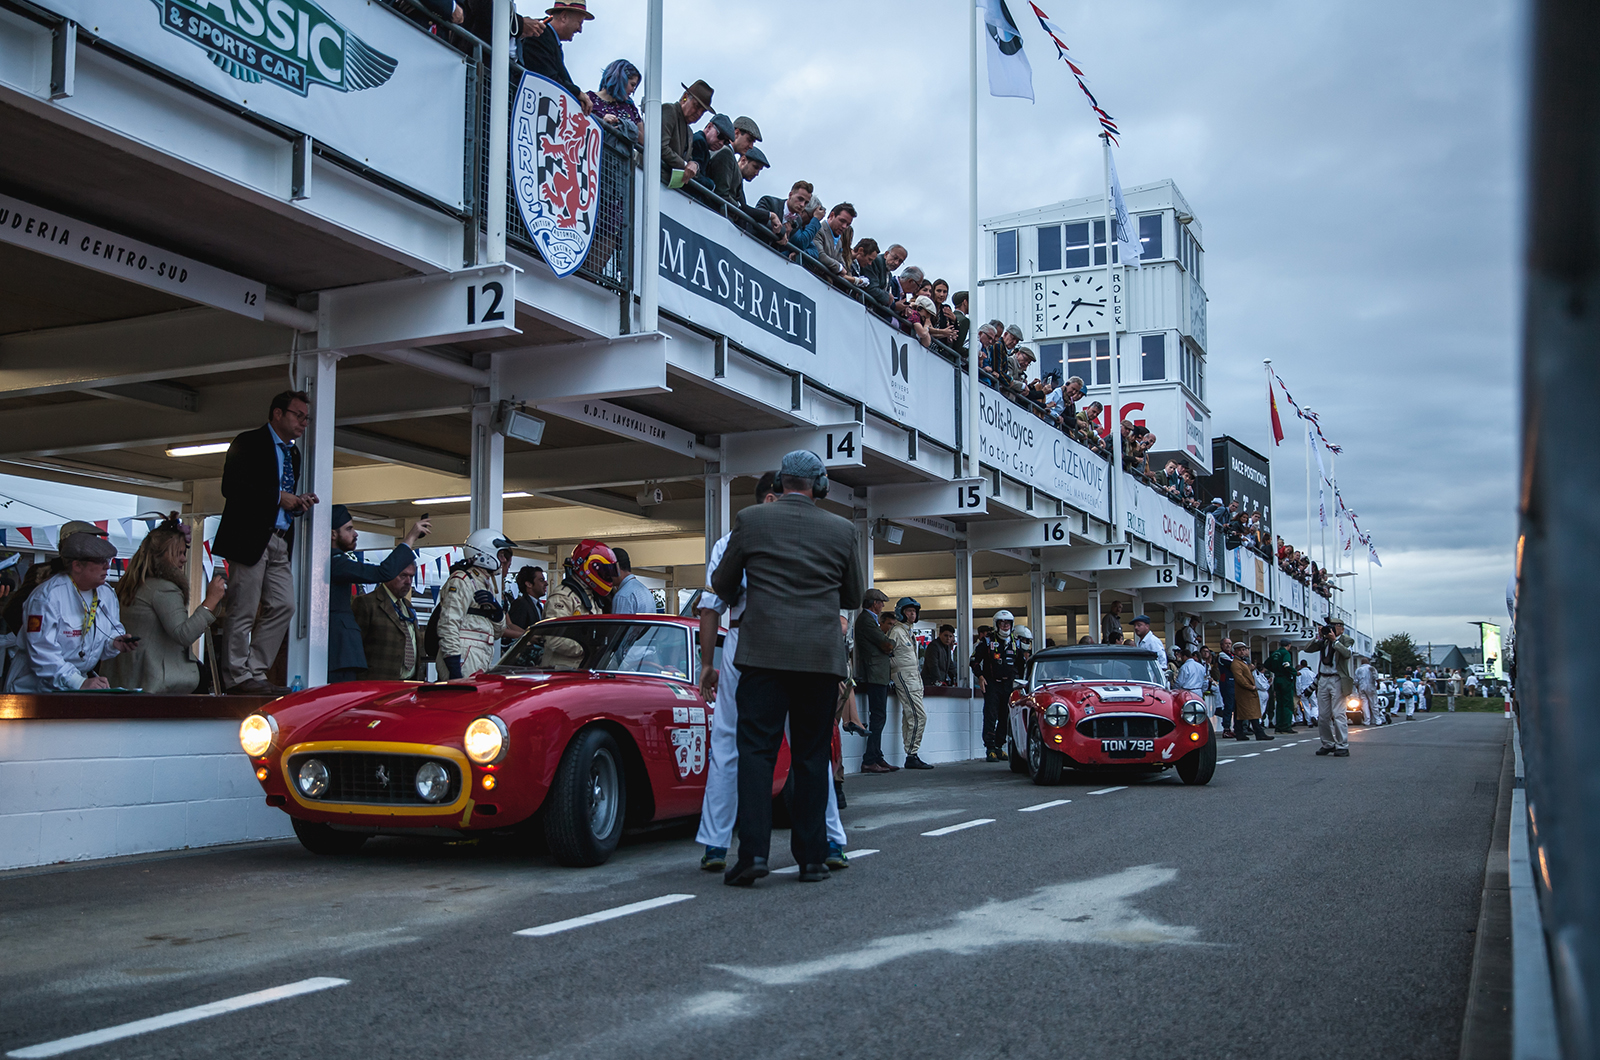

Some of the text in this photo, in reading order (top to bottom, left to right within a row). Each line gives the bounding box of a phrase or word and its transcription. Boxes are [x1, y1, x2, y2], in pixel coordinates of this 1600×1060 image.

[169, 6, 301, 86] & SPORTS CAR
[518, 87, 537, 206] BARC
[80, 235, 188, 284] CENTRO-SUD
[244, 291, 257, 306] 12
[659, 227, 813, 345] MASERATI
[1113, 273, 1122, 325] ROLEX
[466, 281, 505, 325] 12
[1034, 282, 1044, 333] ROLEX
[649, 425, 666, 440] TEAM
[979, 391, 1034, 451] Rolls-Royce
[826, 431, 855, 461] 14
[979, 434, 1034, 477] Motor Cars
[1053, 439, 1102, 492] CAZENOVE
[1231, 456, 1267, 488] RACE POSITIONS
[958, 486, 981, 509] 15
[1043, 523, 1065, 542] 16
[1107, 549, 1124, 566] 17
[1156, 568, 1173, 584] 18
[1194, 584, 1210, 598] 19
[1243, 606, 1260, 618] 20
[1269, 616, 1281, 626] 21
[1284, 623, 1299, 633] 22
[1300, 629, 1314, 639] 23
[1101, 740, 1154, 751] TON 792
